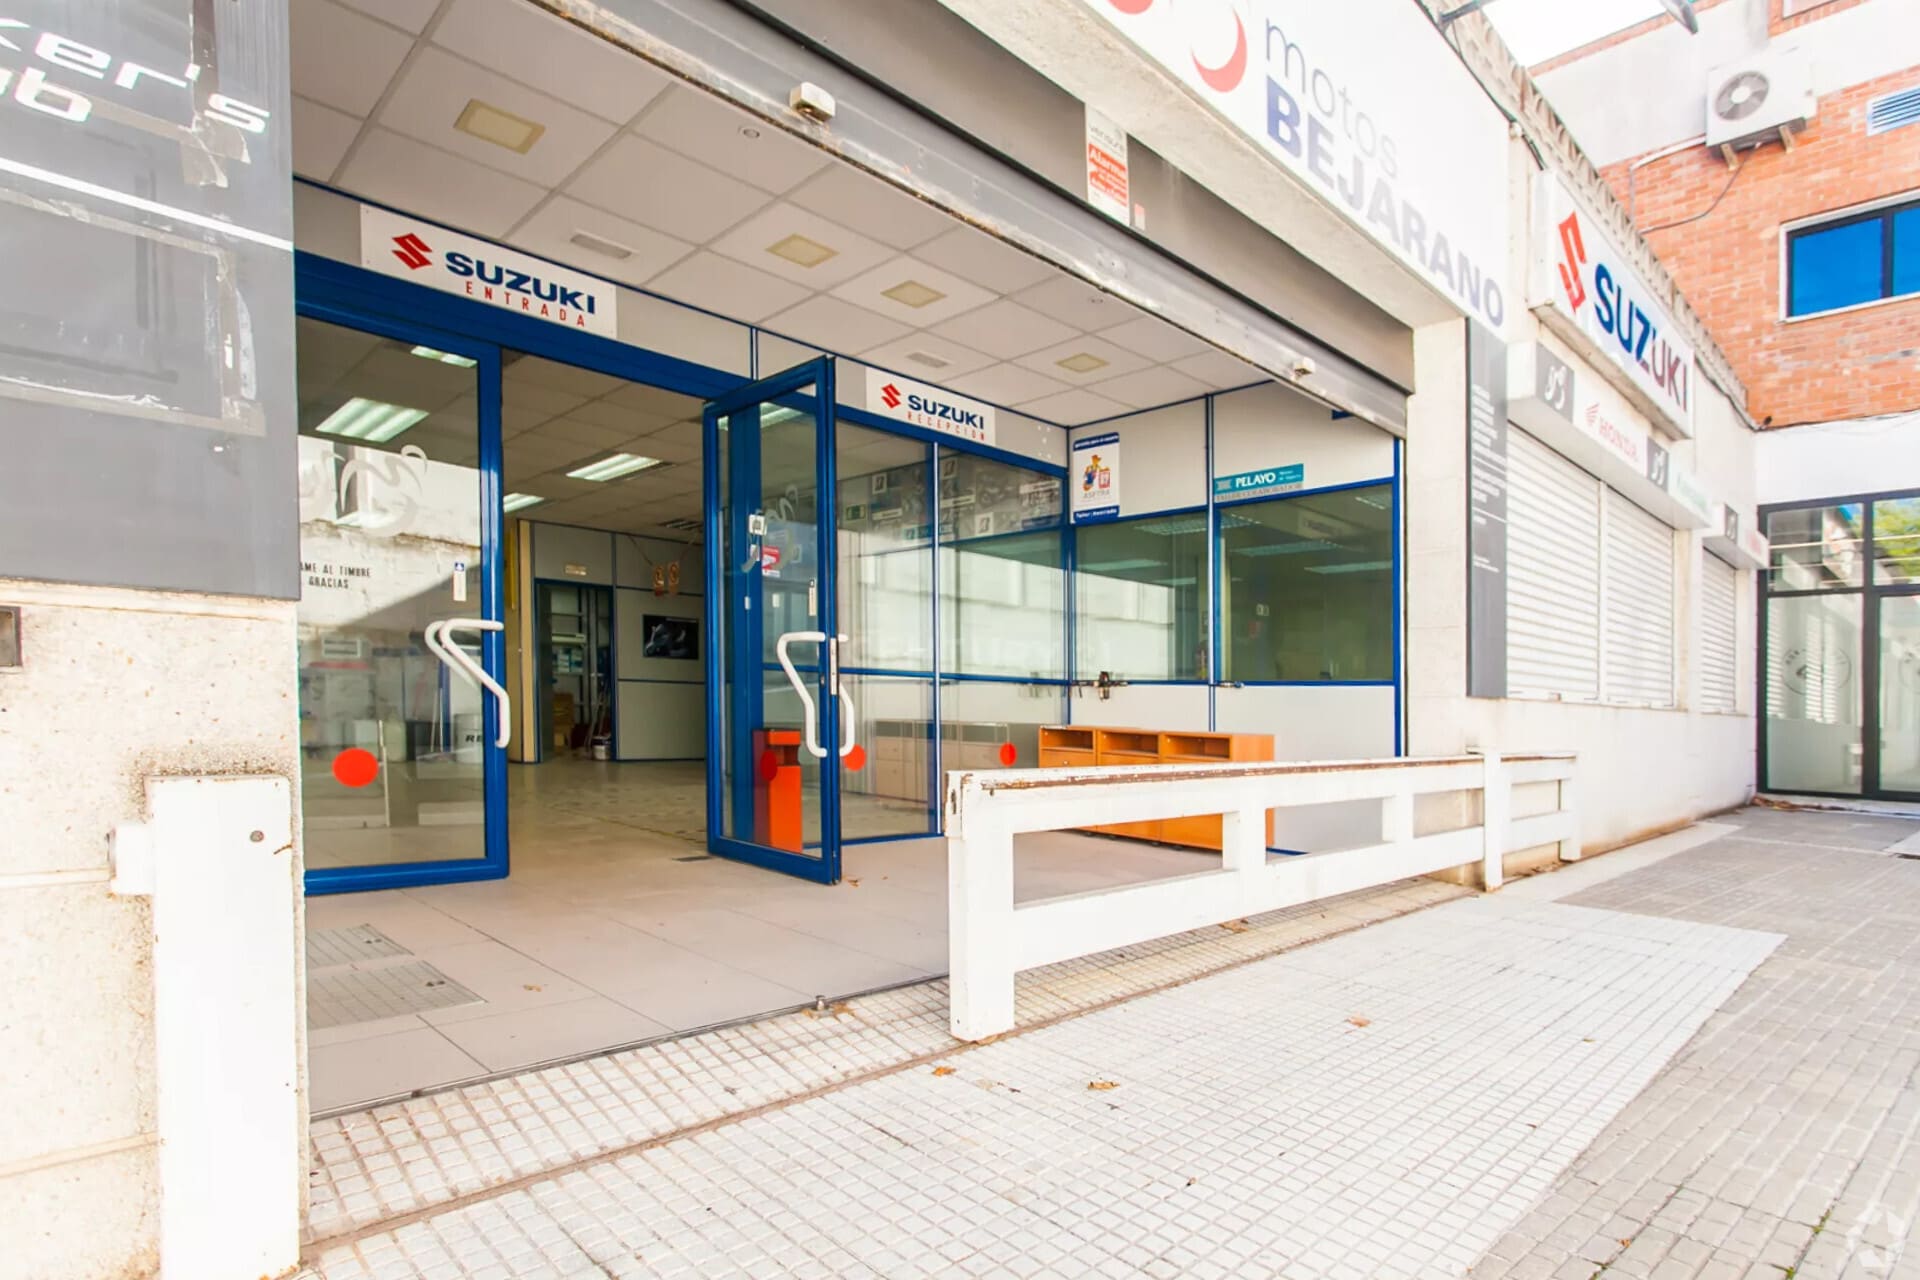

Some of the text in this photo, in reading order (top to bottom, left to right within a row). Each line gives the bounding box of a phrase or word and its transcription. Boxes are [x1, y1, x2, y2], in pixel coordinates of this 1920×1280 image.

[1265, 17, 1399, 179] motos
[1266, 75, 1504, 328] BEJARANO
[445, 252, 595, 314] SUZUKI
[466, 280, 585, 327] ENTRADA
[1594, 262, 1688, 413] SUZUKI
[907, 394, 985, 430] SUZUKI
[1235, 471, 1277, 488] PELAYO
[309, 576, 349, 589] GRACIAS
[323, 564, 334, 575] AL
[339, 565, 371, 577] TIMBRE
